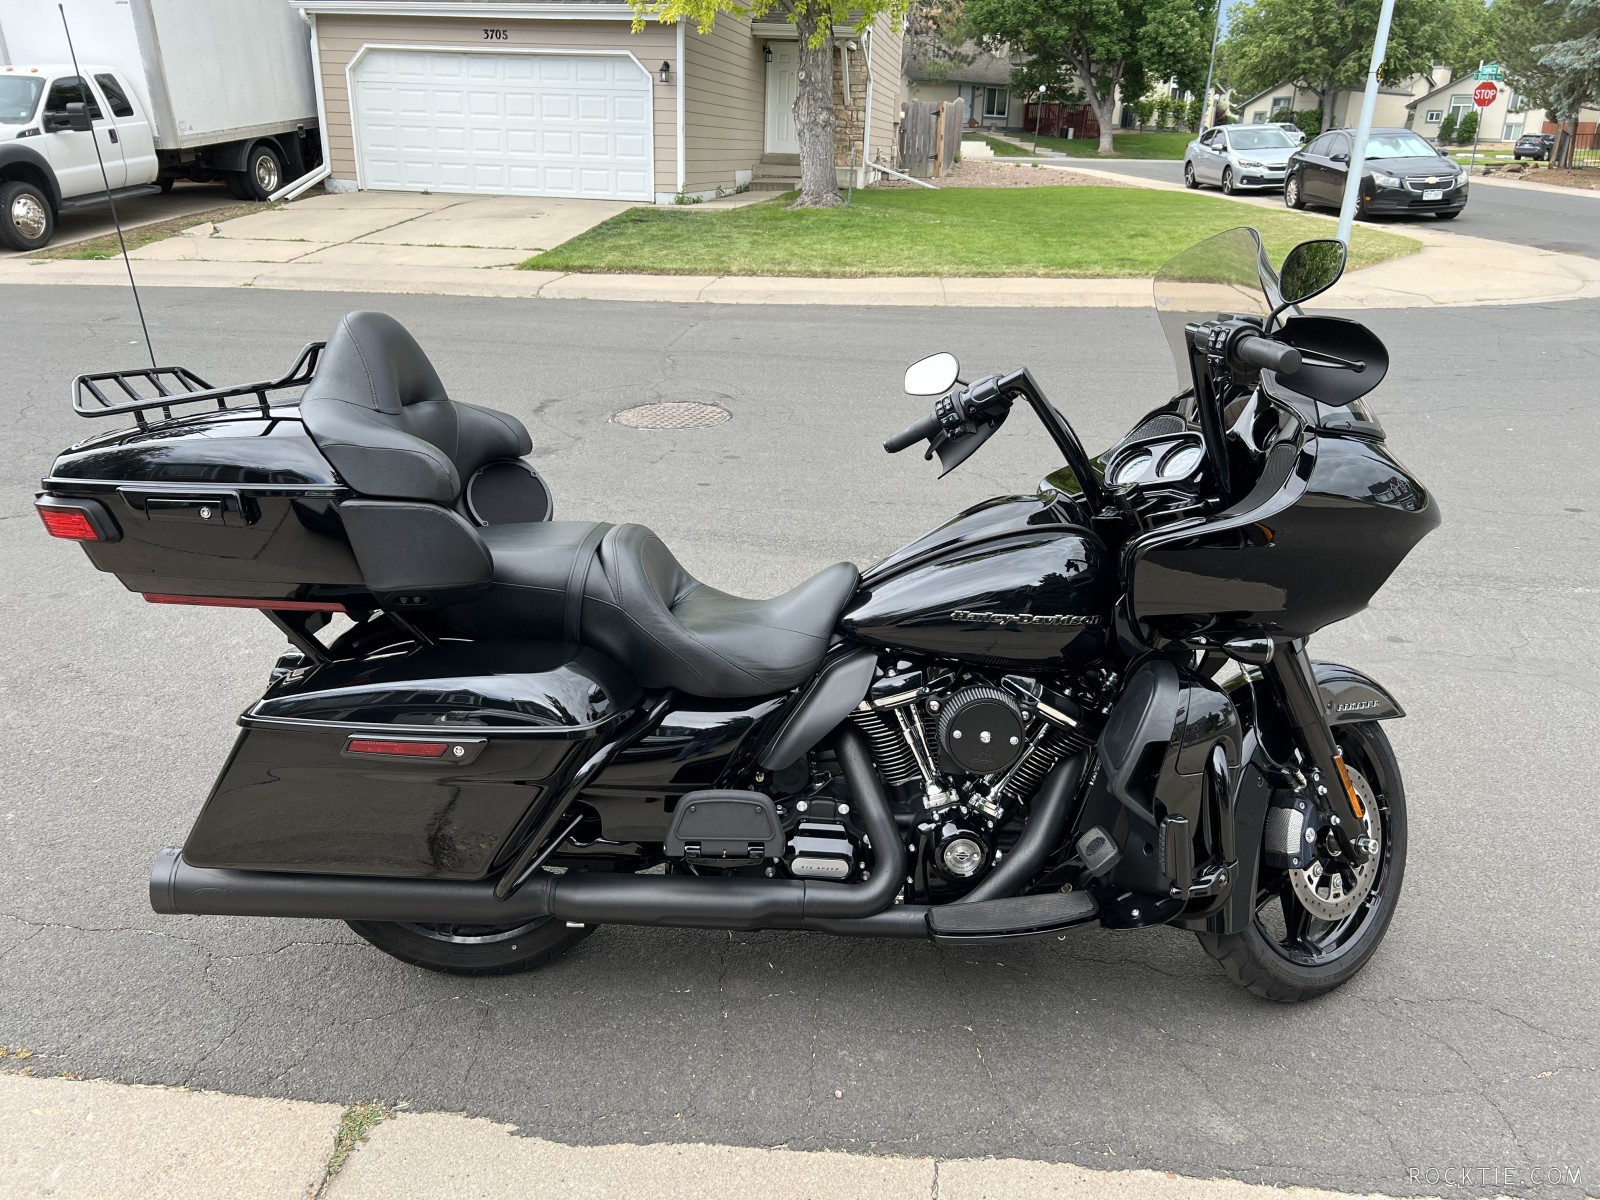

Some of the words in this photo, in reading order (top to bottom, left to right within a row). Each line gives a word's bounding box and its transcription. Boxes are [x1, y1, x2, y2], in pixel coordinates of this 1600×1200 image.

[483, 29, 508, 40] 3705
[1474, 89, 1496, 100] STOP
[950, 610, 1102, 626] Harley-Davidson
